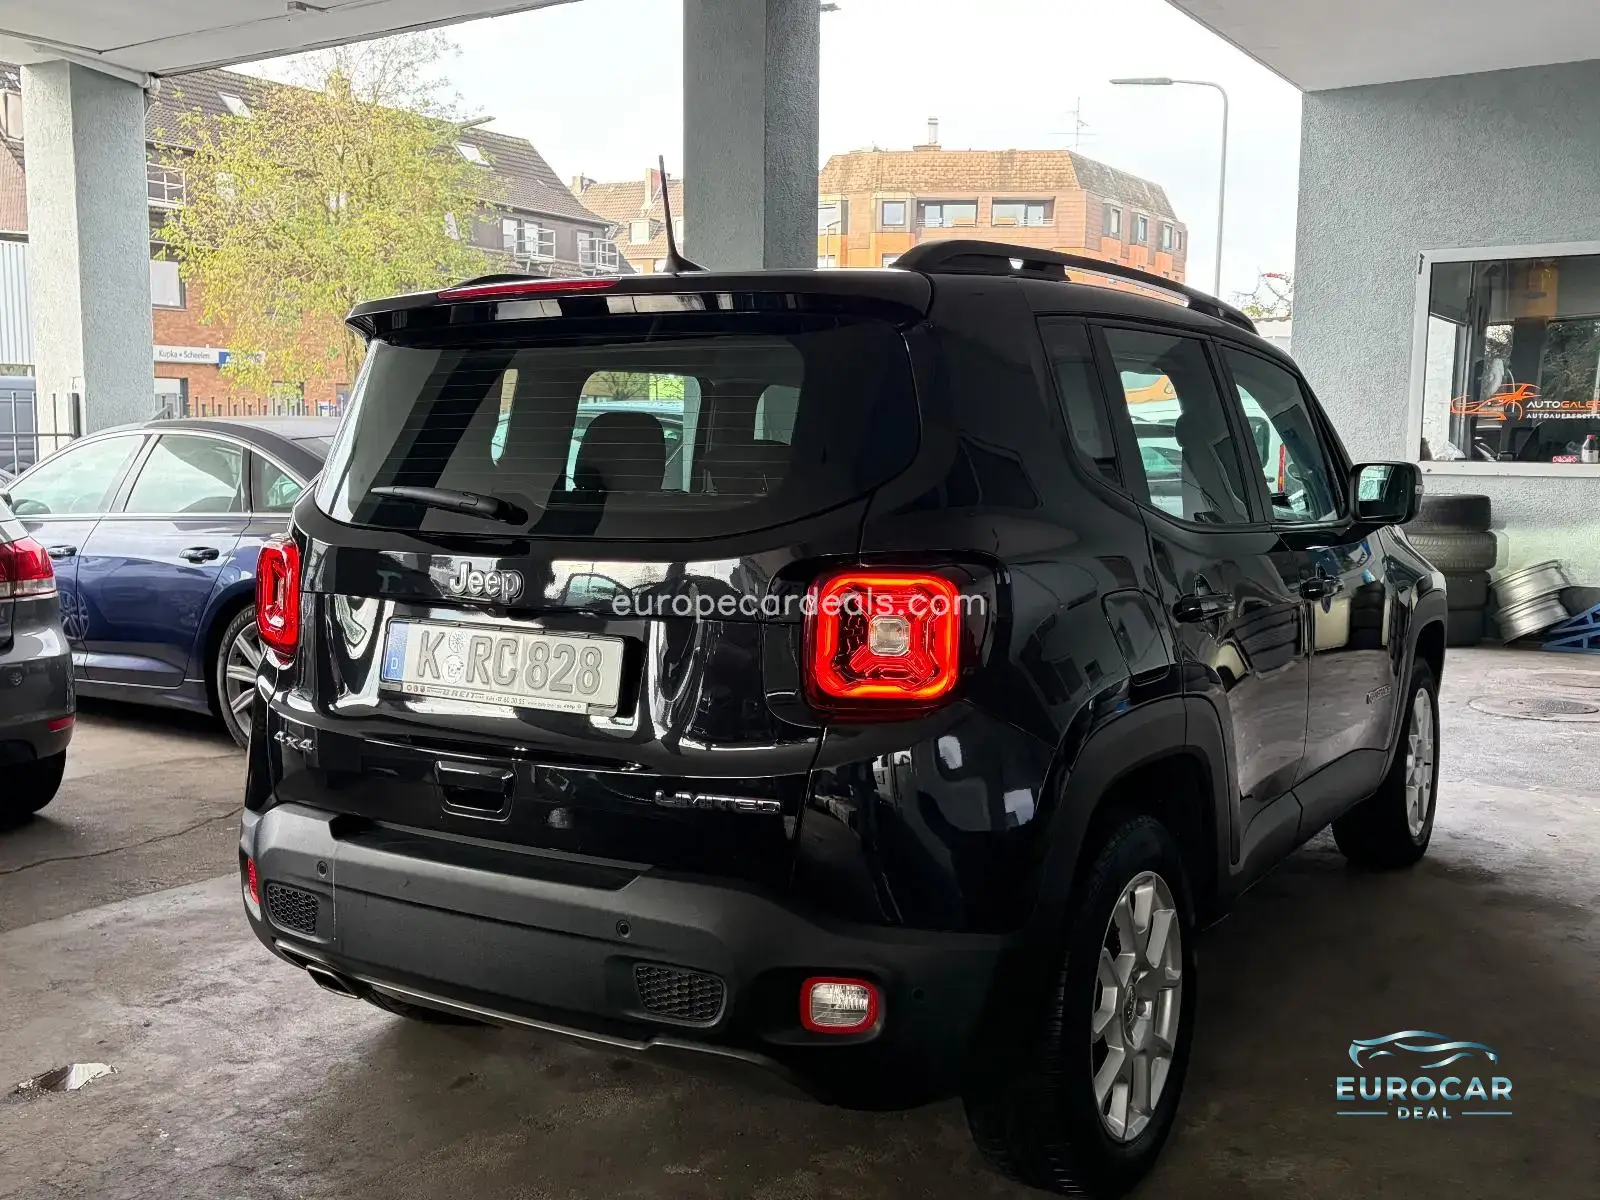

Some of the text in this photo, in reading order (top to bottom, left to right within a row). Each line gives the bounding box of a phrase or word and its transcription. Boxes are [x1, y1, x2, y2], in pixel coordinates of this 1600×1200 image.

[449, 561, 524, 605] Jeep
[417, 630, 446, 680] K
[655, 790, 780, 813] LIMITED
